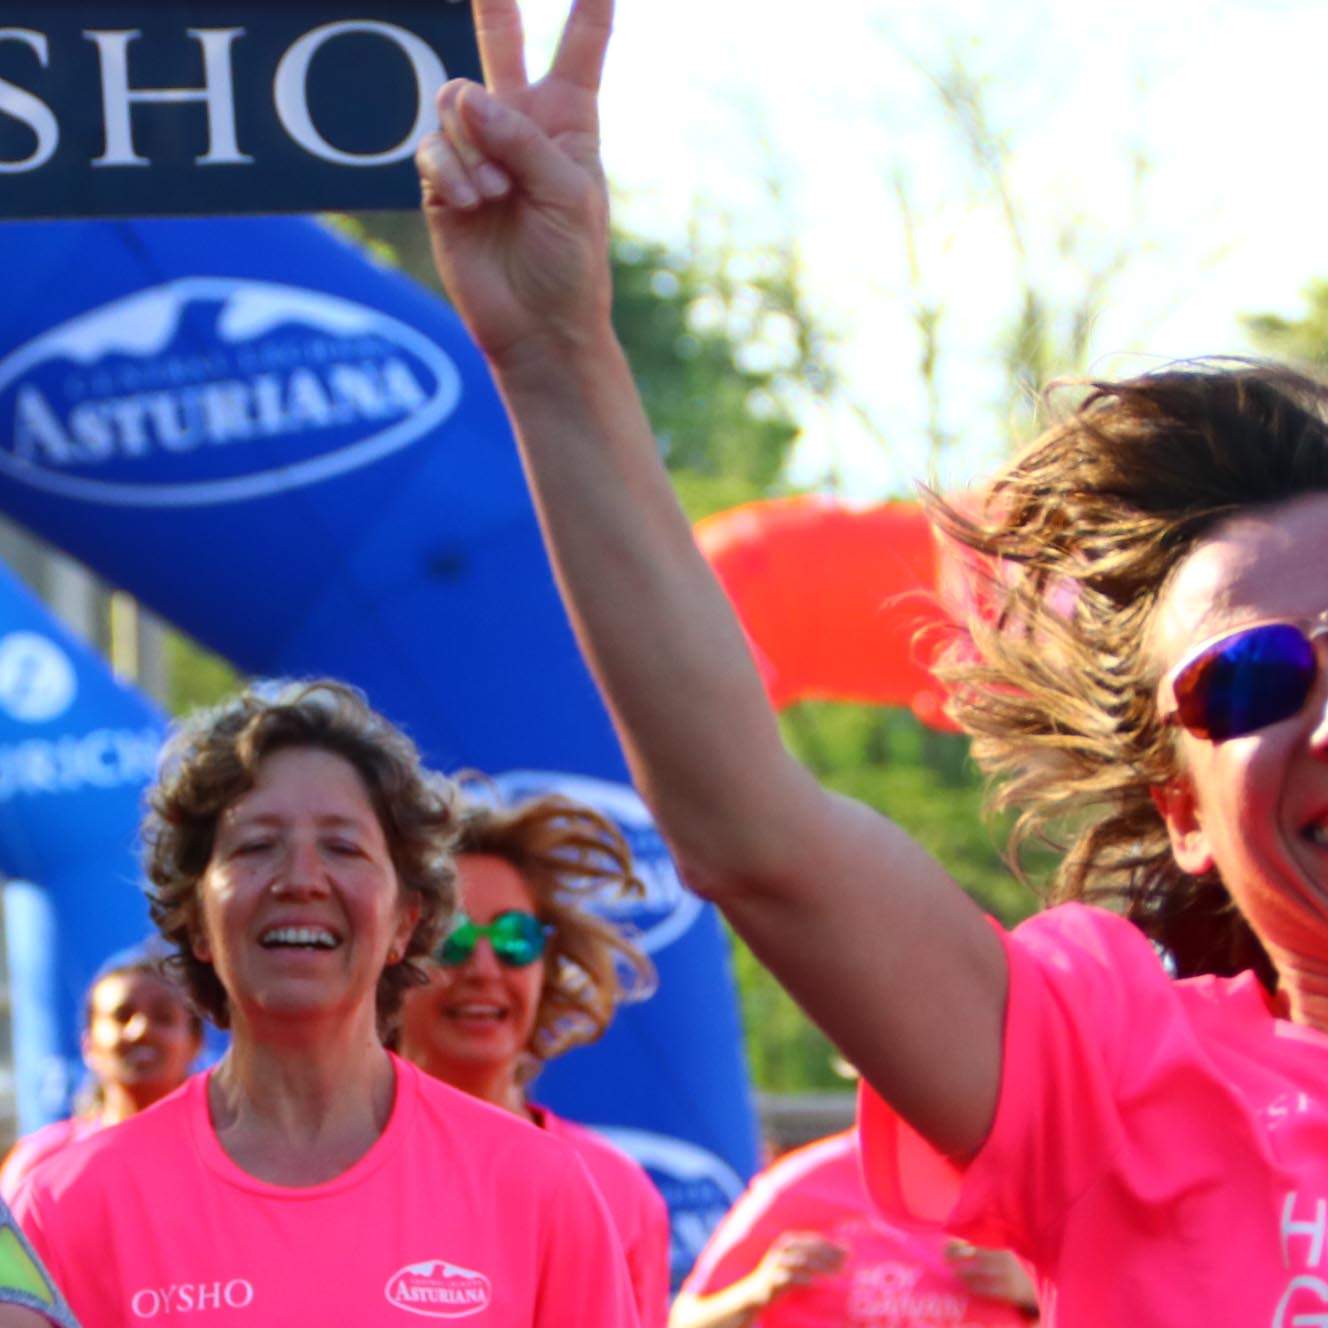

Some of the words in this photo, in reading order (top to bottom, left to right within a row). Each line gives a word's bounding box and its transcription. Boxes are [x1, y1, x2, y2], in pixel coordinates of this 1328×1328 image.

[12, 356, 424, 466] ASTURIANA
[131, 1278, 254, 1318] OYSHO
[395, 1280, 486, 1304] ASTURIANA
